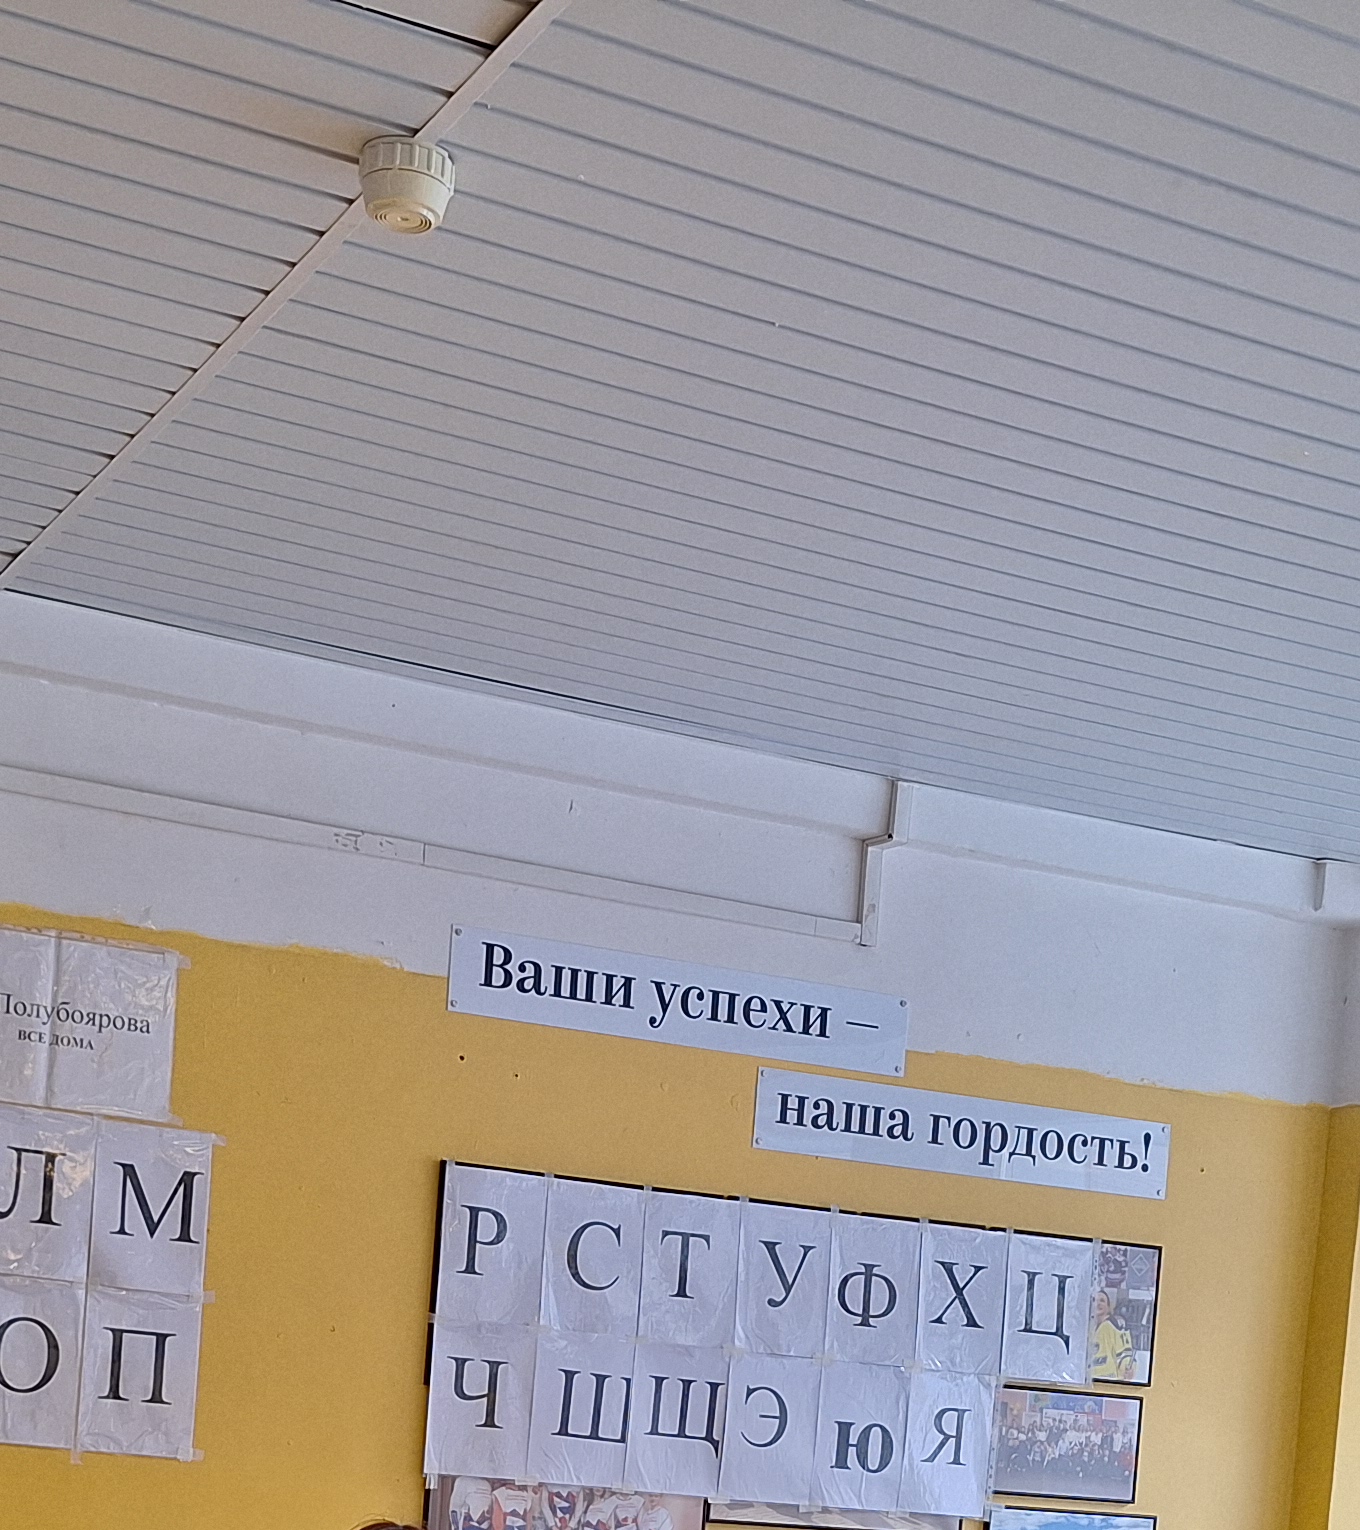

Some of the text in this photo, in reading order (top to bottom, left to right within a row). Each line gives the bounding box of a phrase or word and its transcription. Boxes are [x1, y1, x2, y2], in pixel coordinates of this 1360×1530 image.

[479, 942, 636, 1009] Ваши
[648, 979, 832, 1039] успехи
[17, 1029, 94, 1050] ВСЕ ДОМА
[775, 1092, 1153, 1173] наша гордость!
[109, 1161, 205, 1245] М
[456, 1204, 1075, 1355] Р С Т У Ф Х Ц
[97, 1327, 177, 1406] П
[446, 1355, 509, 1429] Ч
[550, 1368, 633, 1443] Ш
[643, 1374, 726, 1460] Щ
[740, 1384, 789, 1448] Э
[919, 1407, 972, 1466] Я
